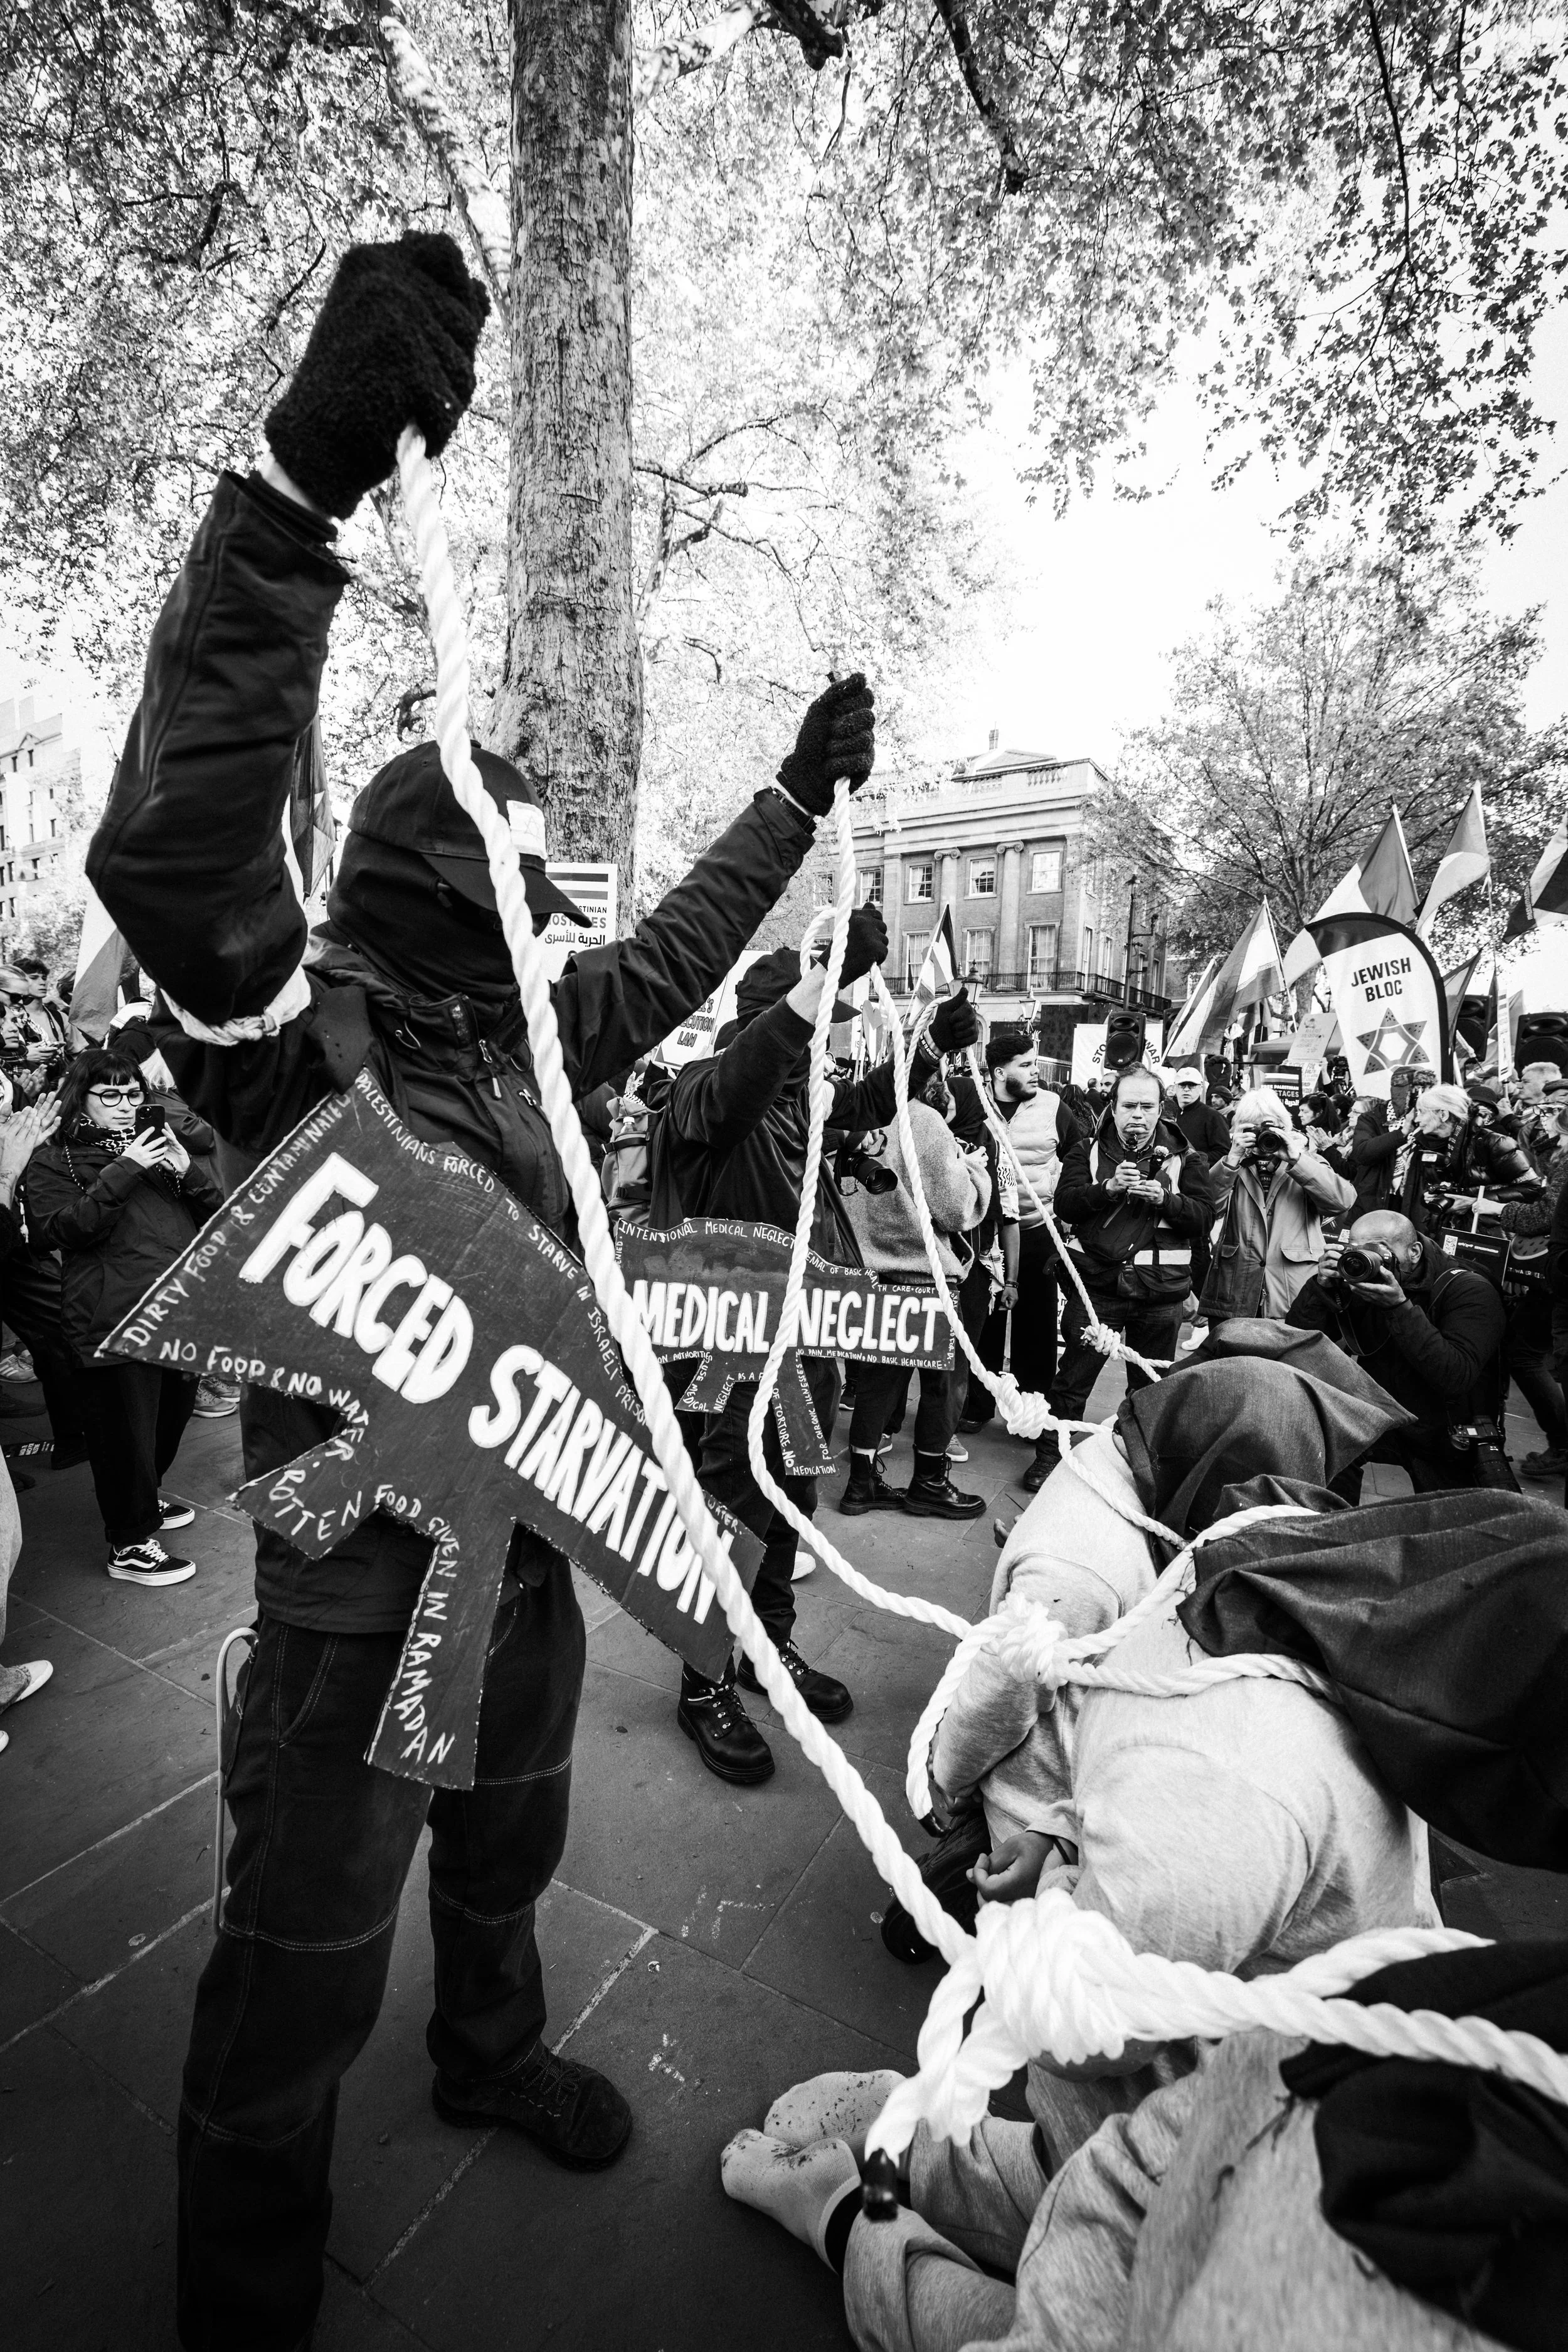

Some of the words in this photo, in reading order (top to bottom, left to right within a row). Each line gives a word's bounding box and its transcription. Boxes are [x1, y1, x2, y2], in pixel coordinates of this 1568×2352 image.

[545, 930, 575, 944] للأسرى
[578, 932, 605, 947] الحرية
[1351, 957, 1411, 987] JEWISH
[1365, 980, 1402, 1002] BLOC
[677, 1030, 697, 1047] LAW
[1092, 1044, 1106, 1064] STO
[1145, 1039, 1160, 1064] WAR
[355, 1073, 436, 1165] PALESTINIANS
[443, 1156, 494, 1192] FORCED
[506, 1197, 519, 1221] TO
[528, 1224, 578, 1279] STARVE
[577, 1286, 591, 1301] IN
[588, 1306, 618, 1380] ISRAELI
[618, 1219, 697, 1243] INTENTIONAL
[705, 1221, 748, 1237] MEDICAL
[753, 1227, 795, 1249] NEGLECT
[805, 1252, 825, 1273] ENIAL
[845, 1268, 862, 1276] BASIC
[122, 1278, 189, 1347] DIRTY
[183, 1231, 227, 1283] FOOD
[239, 1152, 474, 1404] FORCED
[632, 1279, 770, 1353] MEDICAL
[786, 1288, 945, 1353] NEGLECT
[159, 1338, 196, 1361] NO
[207, 1345, 265, 1378] FOOD
[288, 1372, 322, 1396] NO
[673, 1350, 712, 1364] AUTHORITIES
[827, 1350, 862, 1360] MEDICATION
[867, 1355, 877, 1363] NO
[696, 1365, 709, 1382] USE
[683, 1384, 709, 1411] MEDICAL
[714, 1375, 735, 1413] NEGLECT
[772, 1388, 780, 1399] OF
[808, 1408, 823, 1439] CHRONIC
[782, 1450, 796, 1468] NO
[820, 1443, 832, 1459] FOR
[793, 1464, 836, 1475] MEDICATION
[468, 1345, 734, 1625] STARVATION
[269, 1470, 362, 1540] ROTTEN
[375, 1484, 421, 1517] FOOD
[428, 1517, 460, 1577] GIVEN
[422, 1592, 449, 1621] IN
[394, 1633, 455, 1764] RAMADAN
